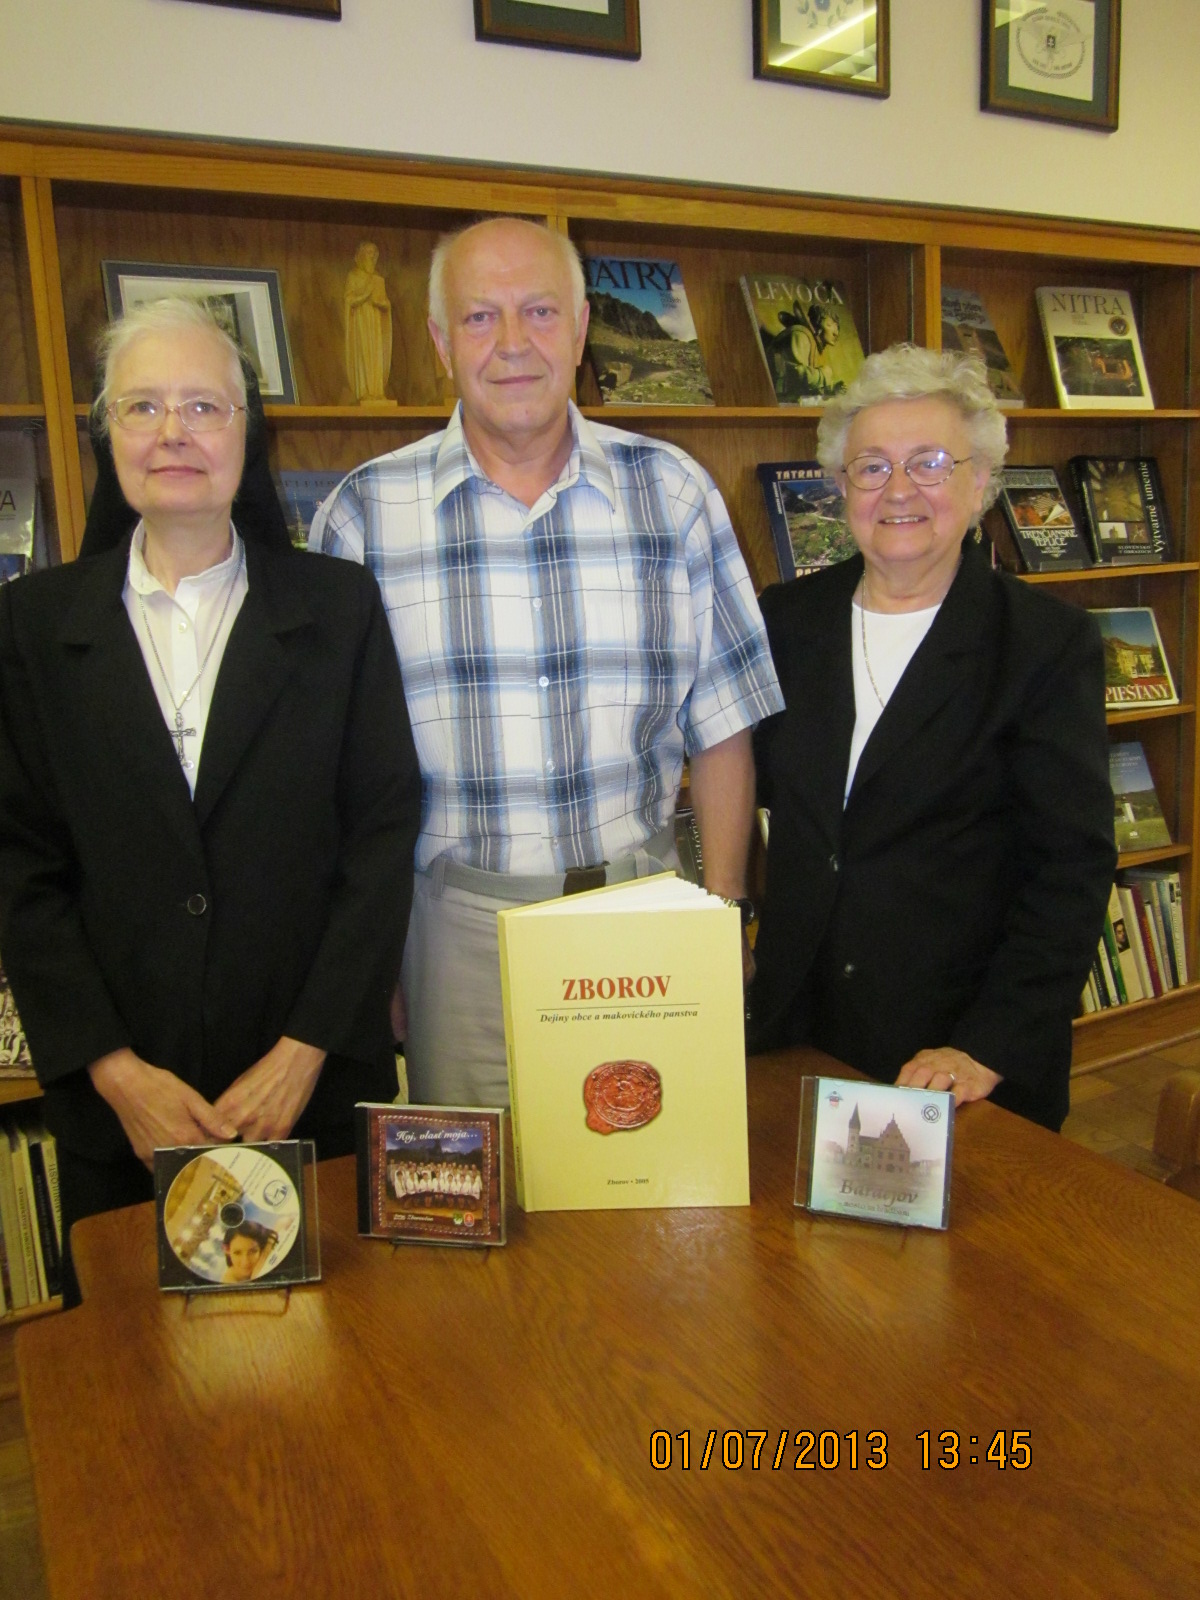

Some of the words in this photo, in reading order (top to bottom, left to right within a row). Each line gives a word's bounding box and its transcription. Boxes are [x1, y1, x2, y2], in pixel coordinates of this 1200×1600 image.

[584, 258, 678, 291] TATRY
[1051, 293, 1127, 316] NITRA
[776, 469, 823, 480] TATRAN
[1138, 461, 1155, 500] umenie
[1145, 504, 1166, 554] Výtvarné
[1033, 537, 1068, 547] TEPLICE
[562, 975, 672, 1001] ZBOROV
[540, 1013, 570, 1023] Dejiny
[571, 1012, 592, 1021] obce
[602, 1010, 661, 1020] makovického
[663, 1009, 698, 1019] panstva
